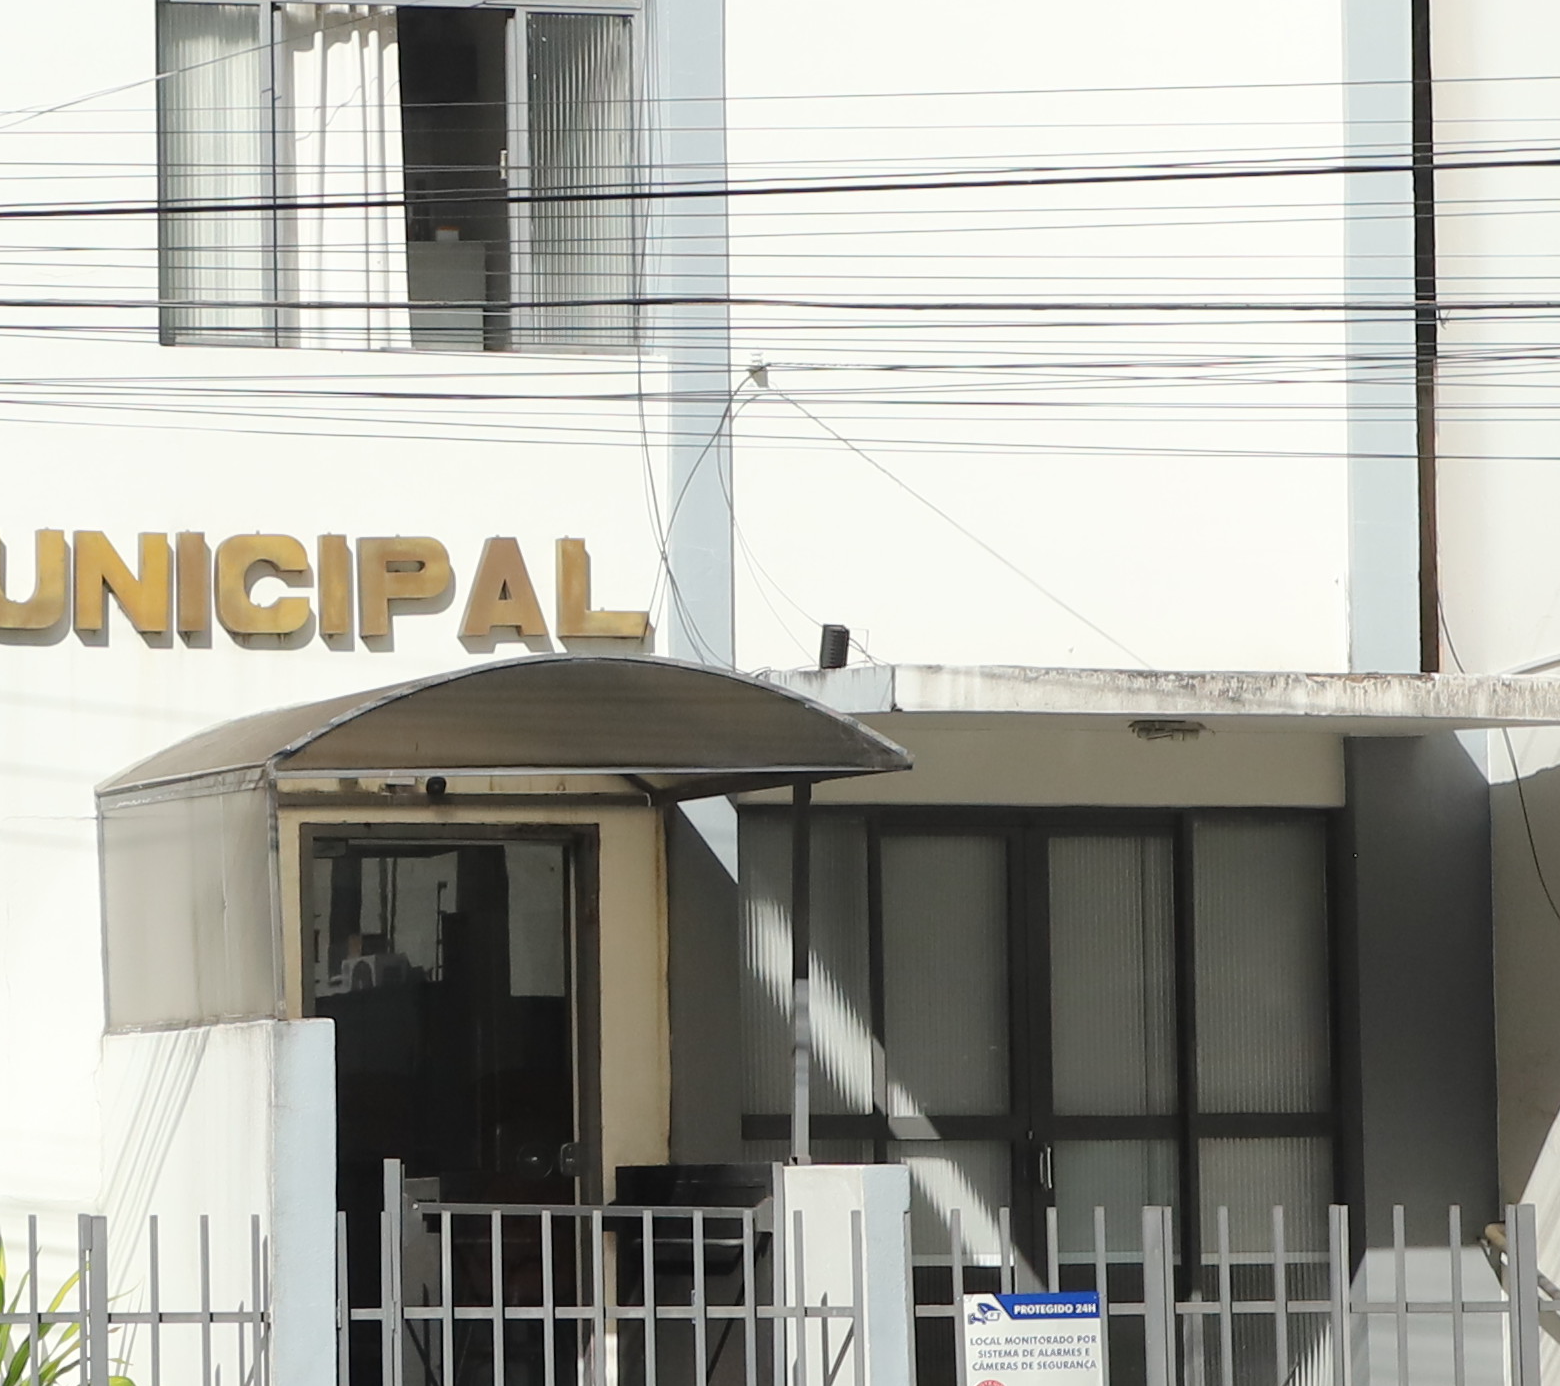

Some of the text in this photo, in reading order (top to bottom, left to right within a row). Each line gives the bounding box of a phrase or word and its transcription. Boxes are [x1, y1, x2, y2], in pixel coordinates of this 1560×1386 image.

[1013, 1303, 1097, 1315] PROTEGIDO 24H
[970, 1335, 1097, 1346] LOCAL MONITORADO POR
[978, 1347, 1090, 1358] SISTEMA DE ALARMES E
[972, 1360, 1097, 1372] CÂMERAS DE SEGURANÇA
